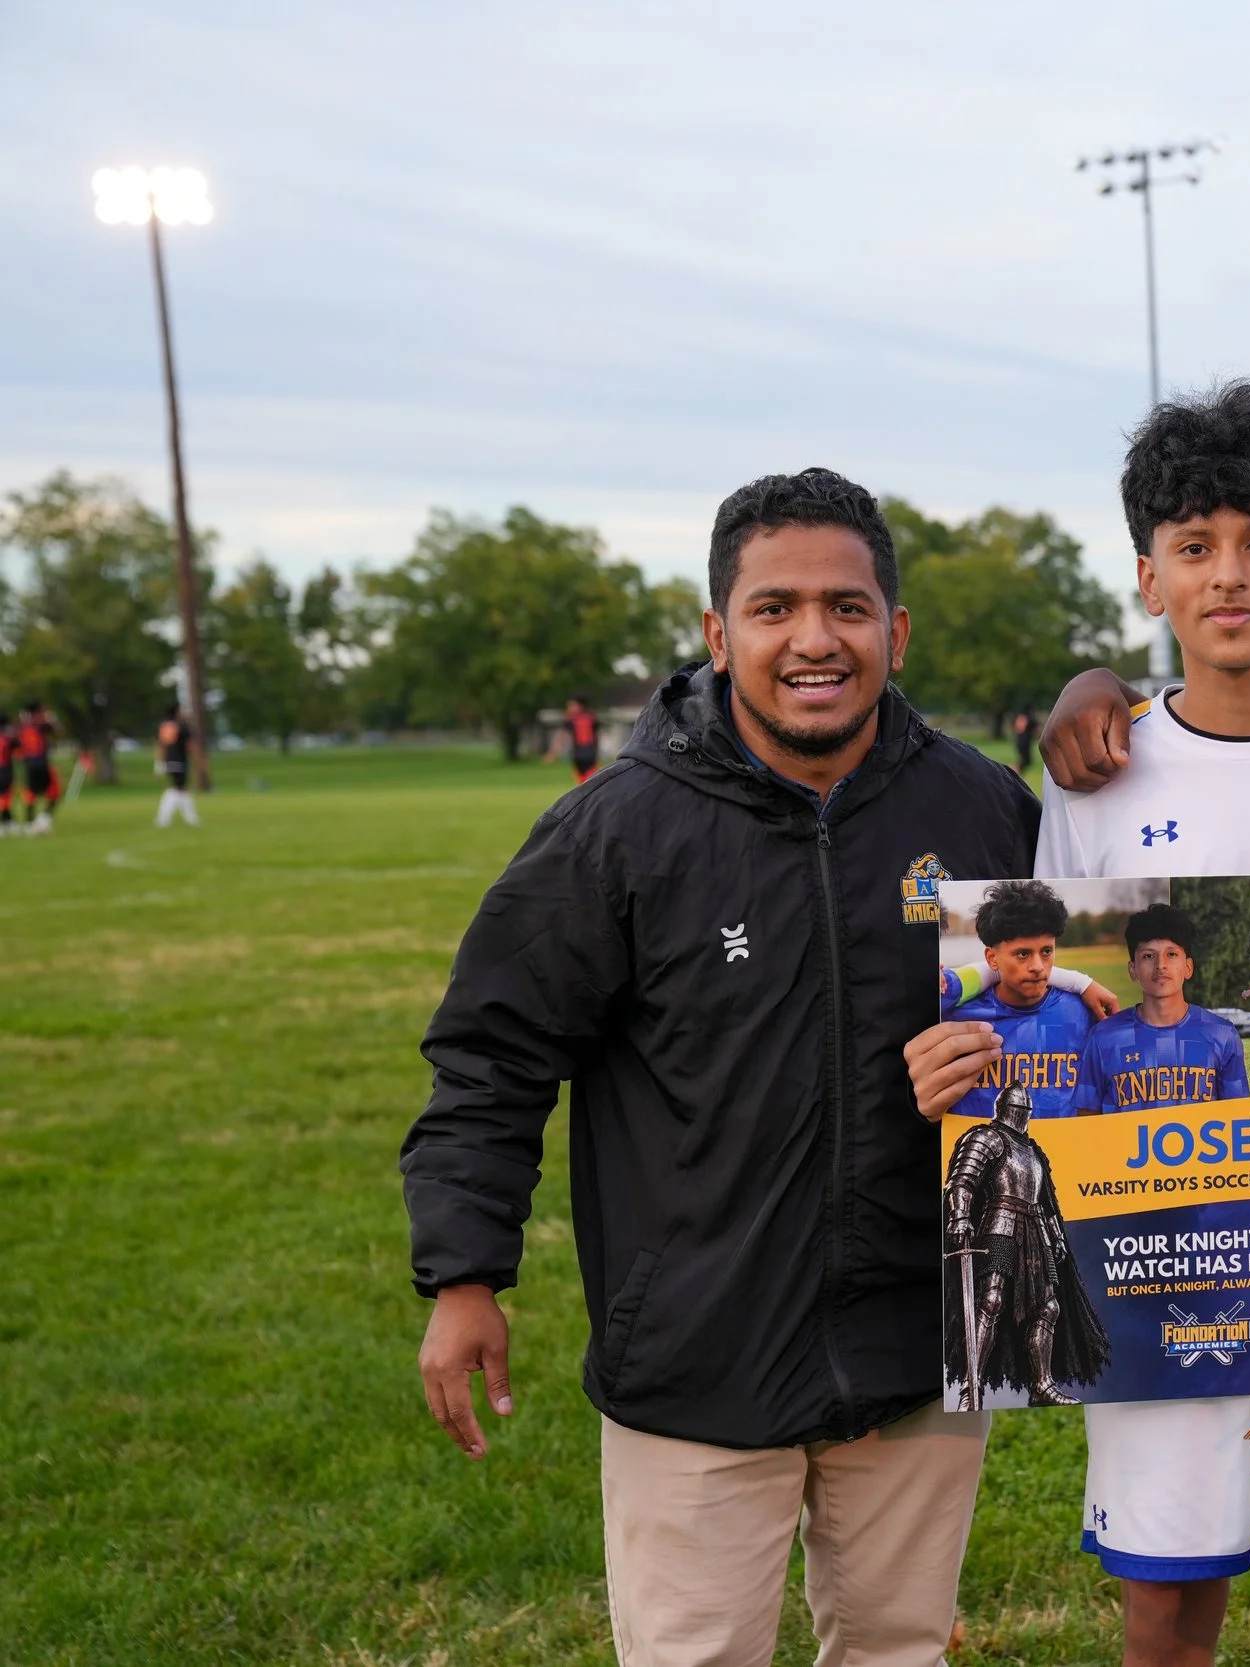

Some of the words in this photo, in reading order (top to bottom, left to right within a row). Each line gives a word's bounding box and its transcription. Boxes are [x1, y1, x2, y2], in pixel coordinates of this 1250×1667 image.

[903, 904, 939, 921] KNIG
[972, 1053, 1078, 1089] NIGHTS
[1113, 1066, 1217, 1107] KNIGHTS
[1078, 1180, 1149, 1196] VARSITY
[1154, 1176, 1198, 1192] BOYS
[1103, 1235, 1169, 1257] YOUR
[1104, 1257, 1190, 1281] WATCH
[1195, 1254, 1243, 1275] HAS
[1107, 1286, 1127, 1297] BUT
[1130, 1284, 1161, 1295] ONCE
[1164, 1284, 1172, 1293] A
[1174, 1280, 1220, 1292] KNIGHT,
[1164, 1320, 1249, 1343] FOUNDATION
[1174, 1341, 1238, 1350] ACADEMIES
